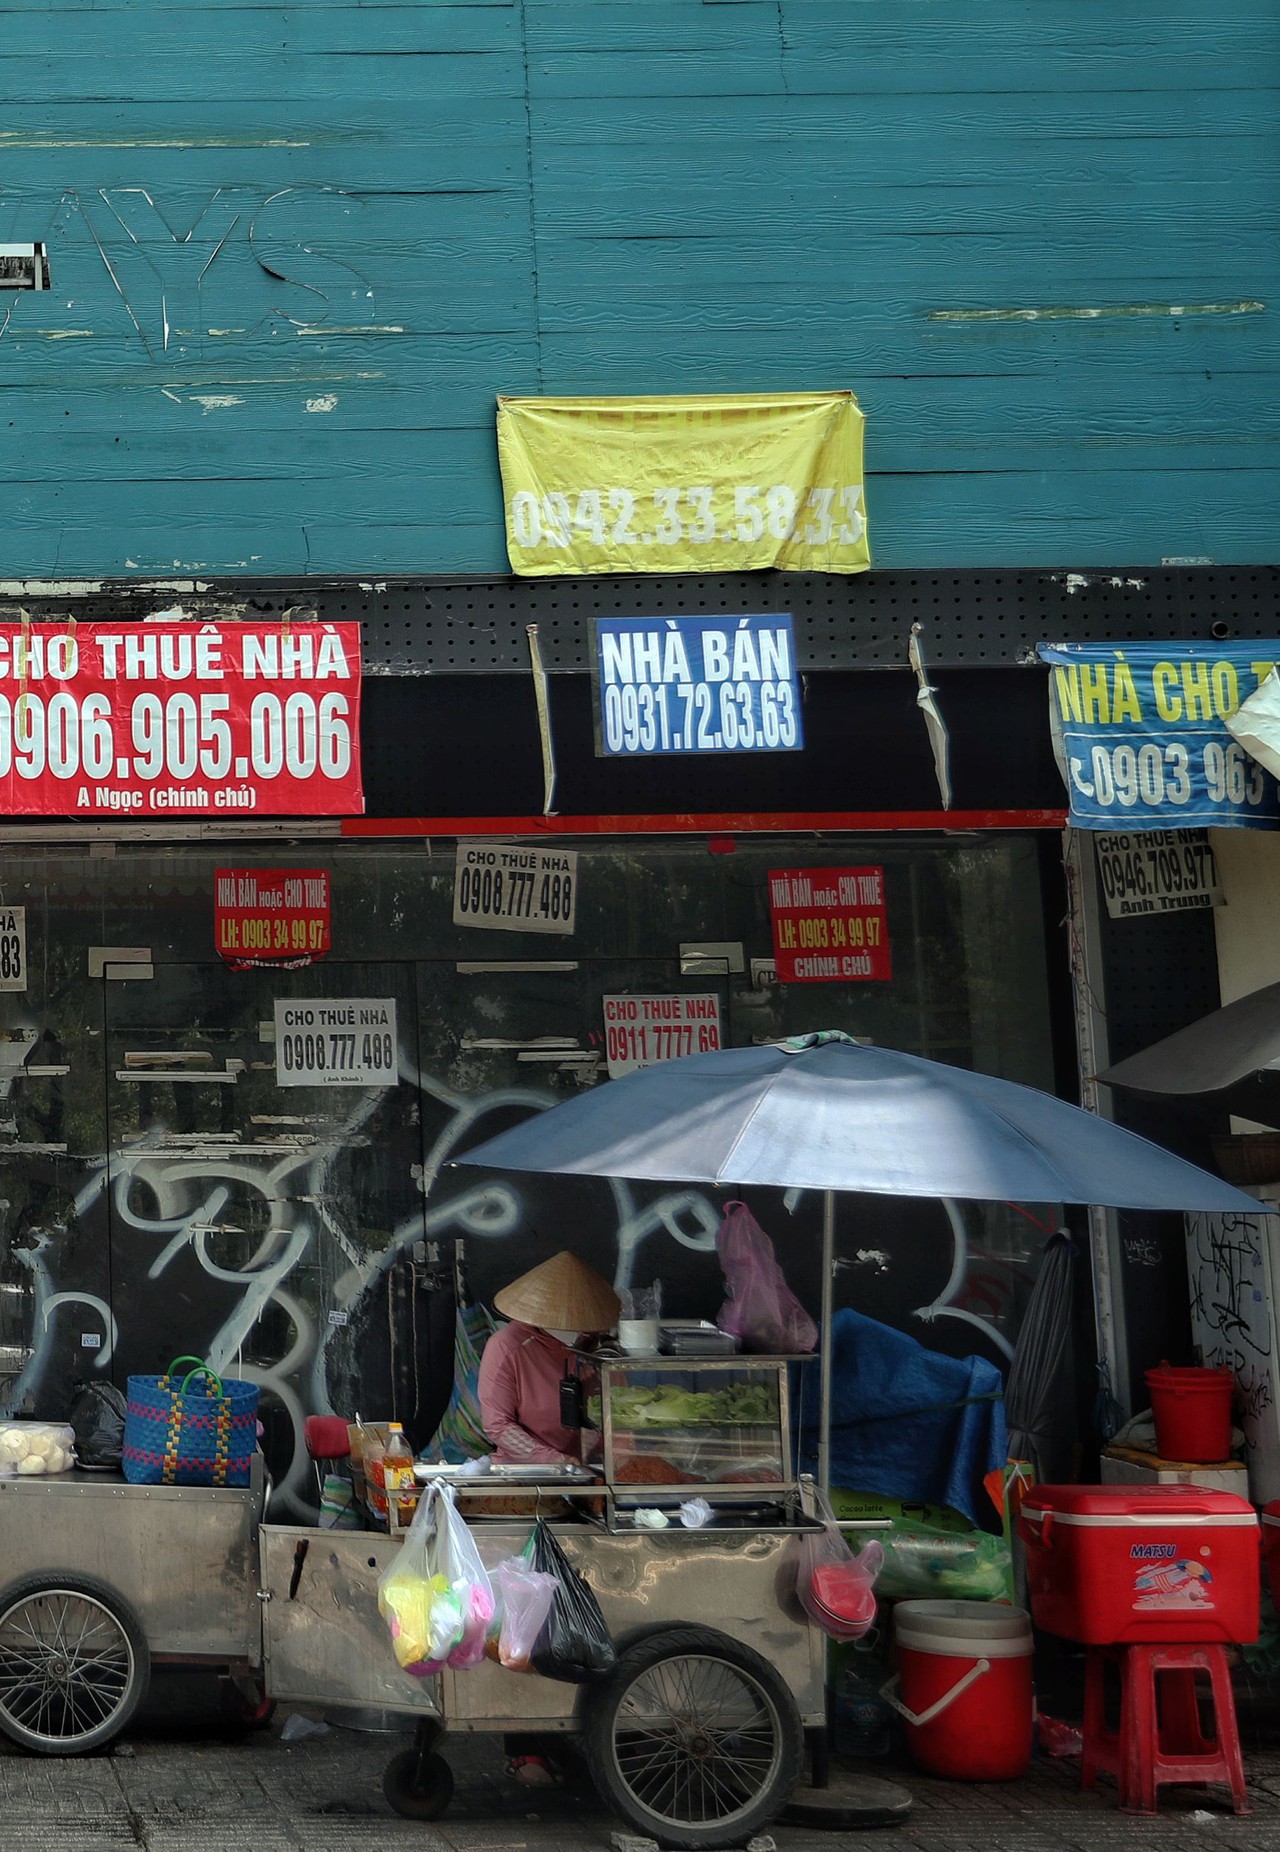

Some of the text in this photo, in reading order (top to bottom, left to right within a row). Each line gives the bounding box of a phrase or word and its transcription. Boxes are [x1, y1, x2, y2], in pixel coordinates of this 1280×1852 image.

[512, 484, 862, 547] 0942.33.58.33
[96, 625, 223, 680] THUÊ
[243, 625, 350, 680] NHÀ
[601, 618, 790, 684] NHÀ BÁN
[1055, 651, 1143, 724] NHÀ
[1152, 661, 1238, 722] CHO
[605, 681, 798, 752] 0931.72.63.63
[1091, 743, 1191, 806] 0903
[77, 784, 256, 812] A Ngọc (chính chủ)
[467, 851, 569, 871] CHO THUÊ NHÀ
[1100, 835, 1130, 853] CHO
[218, 872, 237, 907] NHÀ
[238, 872, 257, 907] BÁN
[284, 878, 303, 908] CHO
[304, 872, 326, 908] THUÊ
[772, 872, 792, 908] NHÀ
[792, 871, 812, 907] BÁN
[838, 876, 857, 906] CHO
[858, 870, 881, 905] THUÊ
[1101, 845, 1217, 899] 0946.709.977
[460, 866, 572, 920] 0908.777.488
[1121, 894, 1210, 914] Anh Trung
[221, 918, 324, 949] LH: 0903 34 99 97
[777, 917, 880, 948] LH: 0903 34 99 97
[794, 949, 872, 977] CHÍNH CHỦ
[285, 1005, 389, 1026] CHO THUÊ NHÀ
[606, 995, 717, 1020] CHO THUÊ NHÀ
[283, 1033, 393, 1070] 0908.777.488
[608, 1025, 648, 1061] 0911
[652, 1025, 692, 1059] 7777
[1130, 1544, 1176, 1558] MATSU
